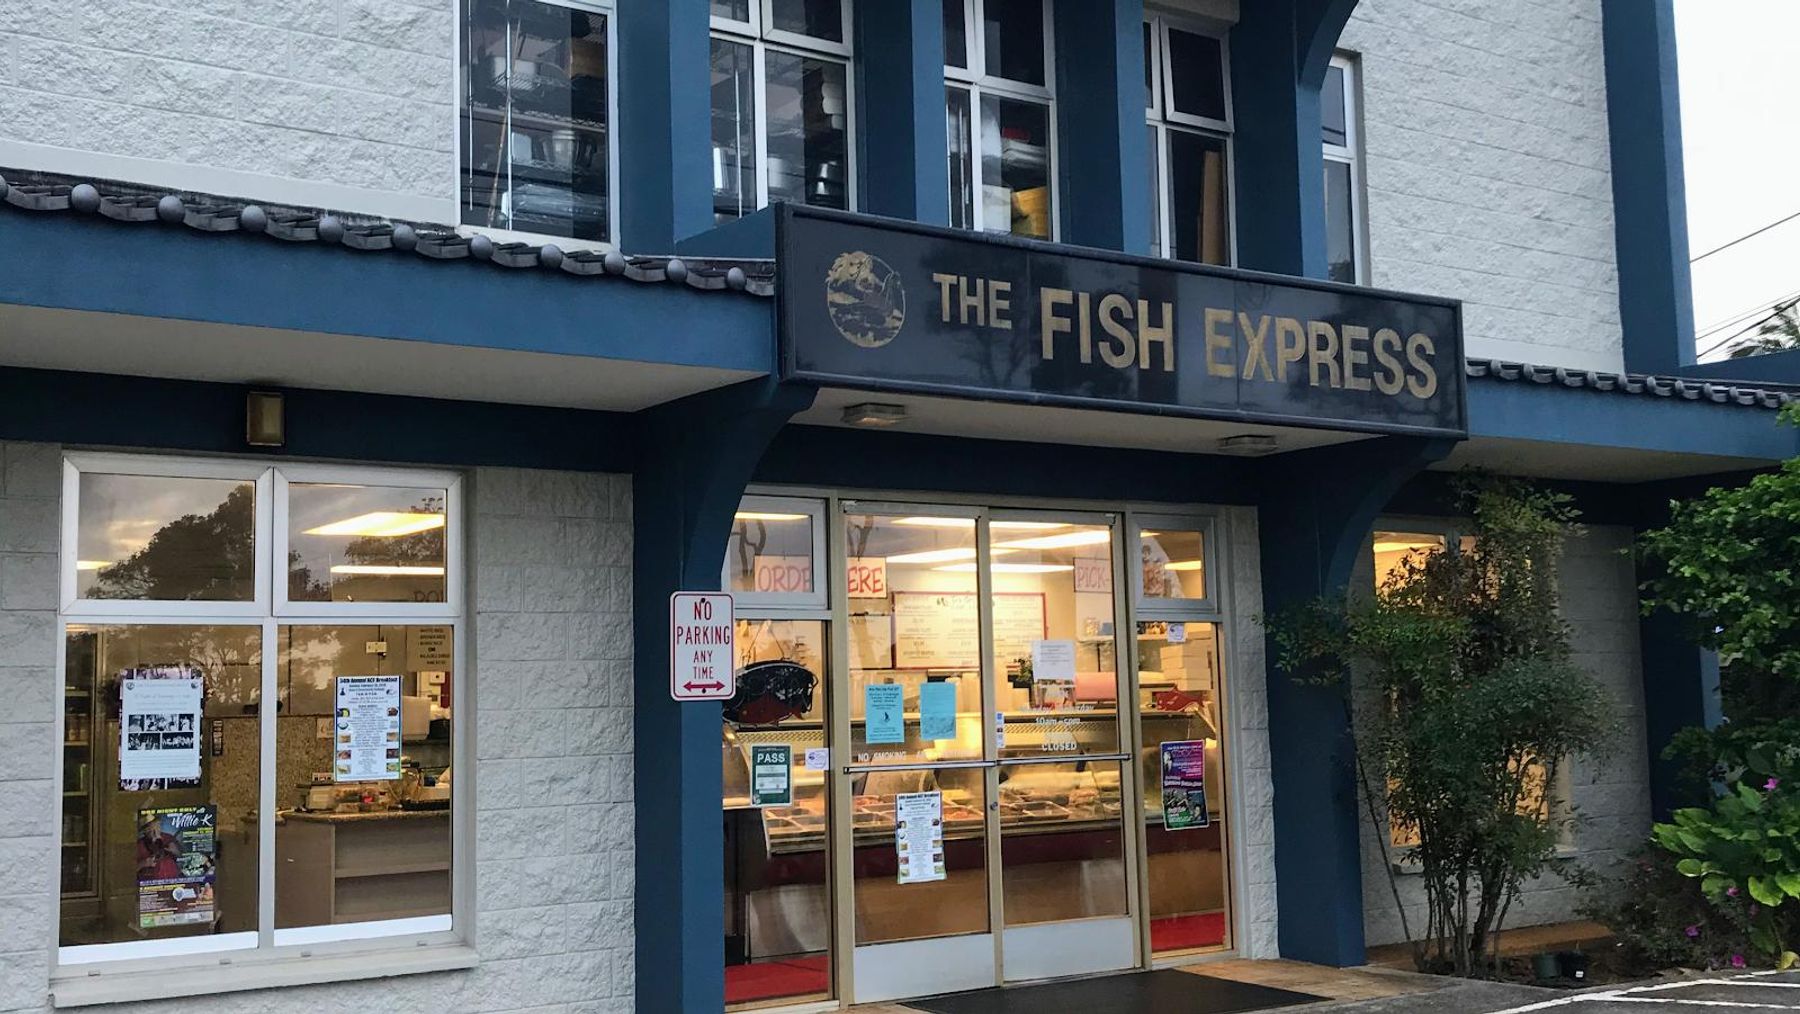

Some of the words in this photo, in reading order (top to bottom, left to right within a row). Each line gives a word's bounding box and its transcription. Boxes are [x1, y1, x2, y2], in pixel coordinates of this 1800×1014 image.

[932, 272, 1012, 330] THE
[1040, 286, 1174, 372] FISH
[1204, 307, 1438, 399] EXPRESS
[758, 565, 812, 592] ORDE
[847, 565, 883, 593] ERE
[1077, 565, 1110, 589] PICK-
[694, 601, 712, 620] NO
[676, 626, 730, 645] PARKING
[693, 650, 713, 663] ANY
[693, 666, 714, 679] TIME
[1042, 743, 1077, 751] CLOSED
[757, 752, 785, 763] PASS
[858, 752, 869, 762] NO
[873, 750, 906, 760] SMOKING
[200, 813, 213, 827] K
